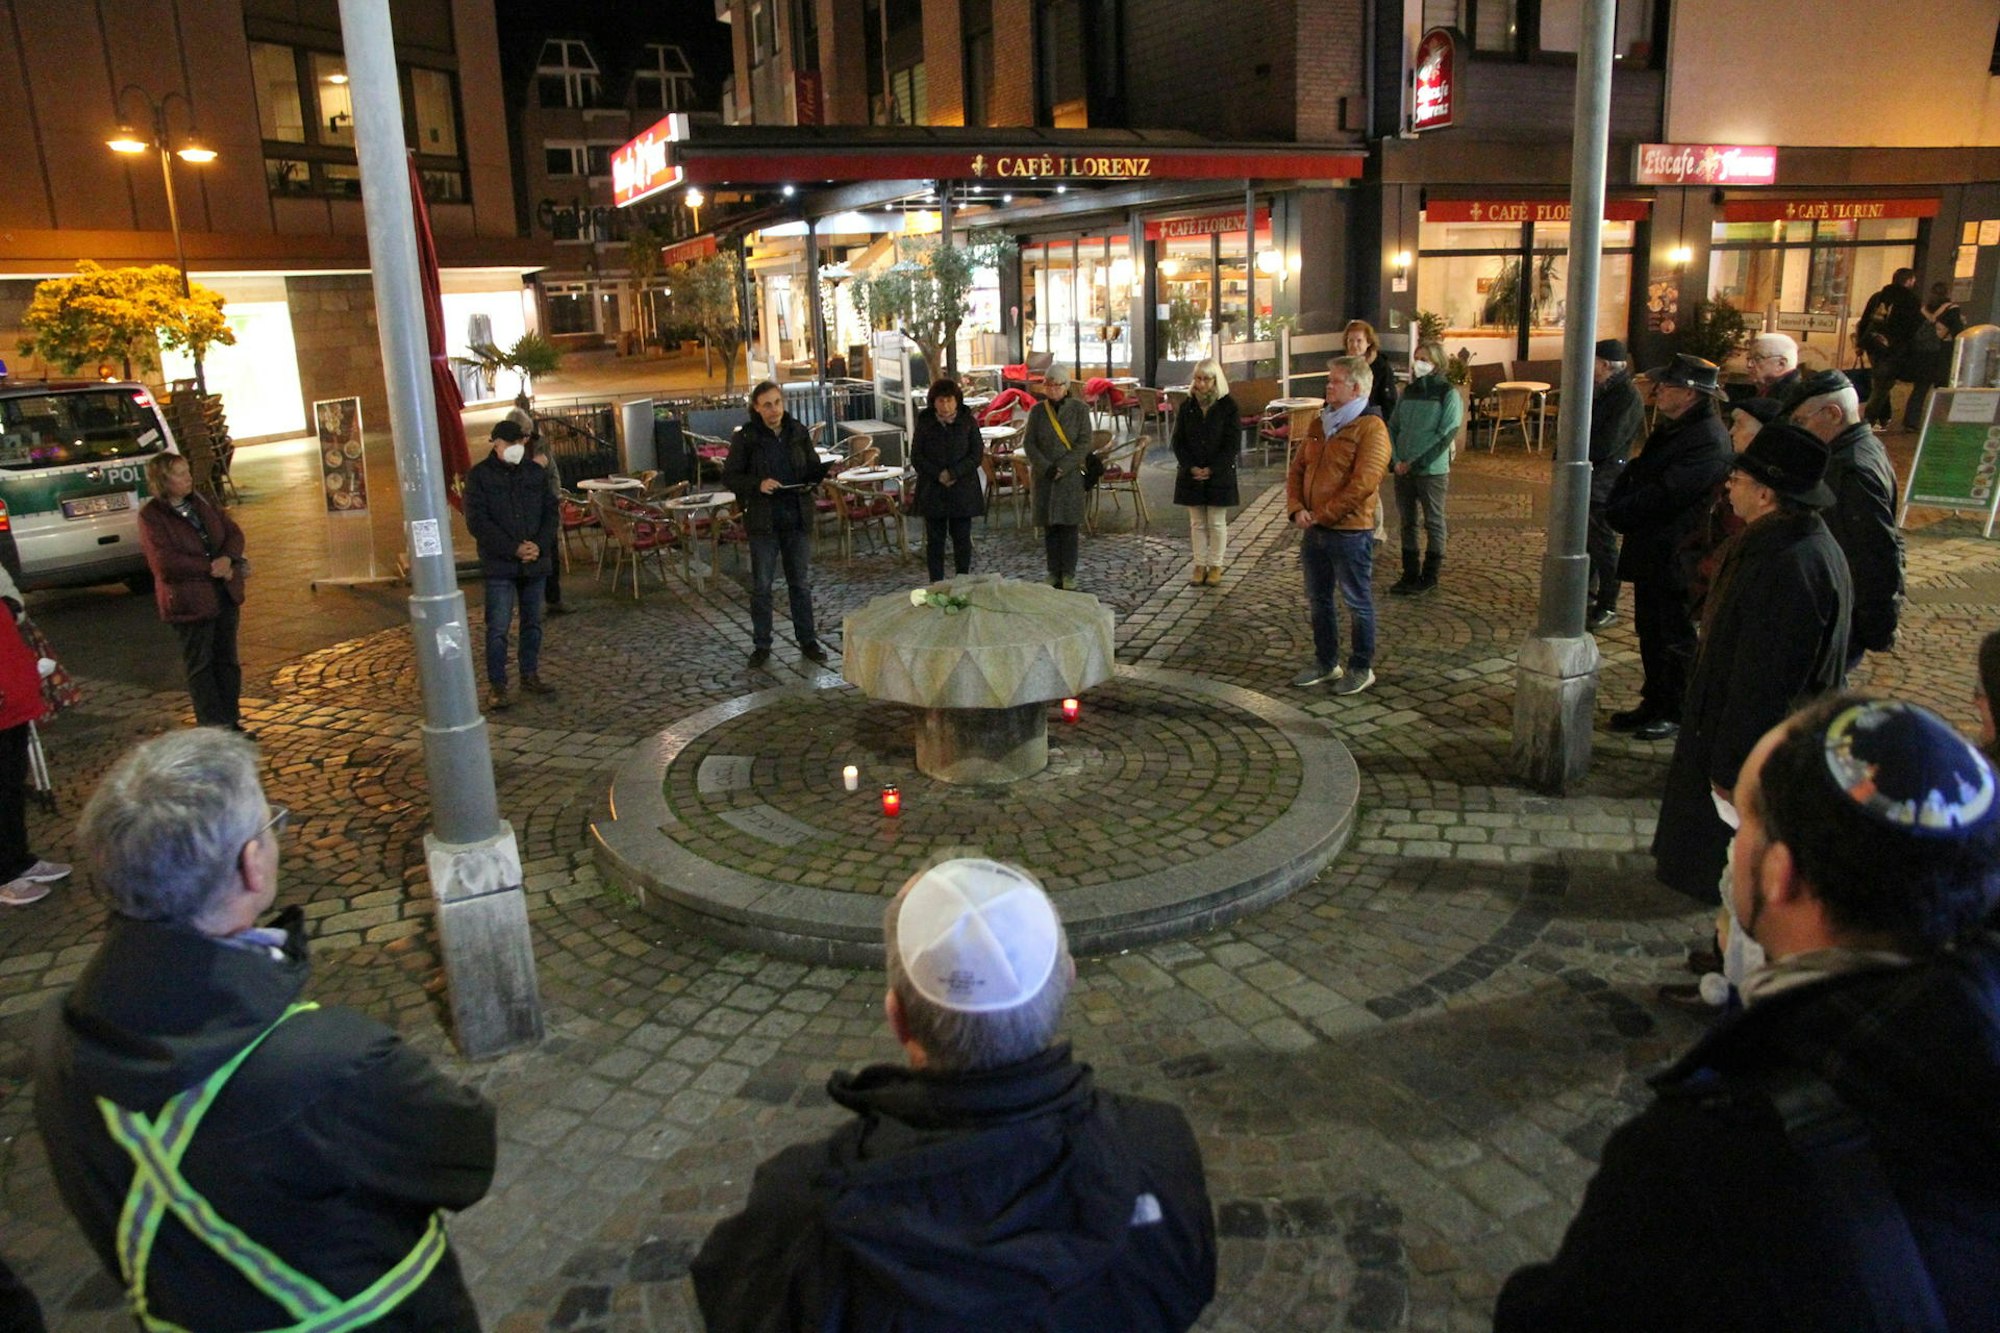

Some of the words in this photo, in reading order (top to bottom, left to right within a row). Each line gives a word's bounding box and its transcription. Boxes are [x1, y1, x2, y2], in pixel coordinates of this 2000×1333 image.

[1059, 157, 1151, 177] FLORENZ
[1644, 147, 1695, 182] Eiscafe
[1832, 203, 1885, 219] FLORENZ
